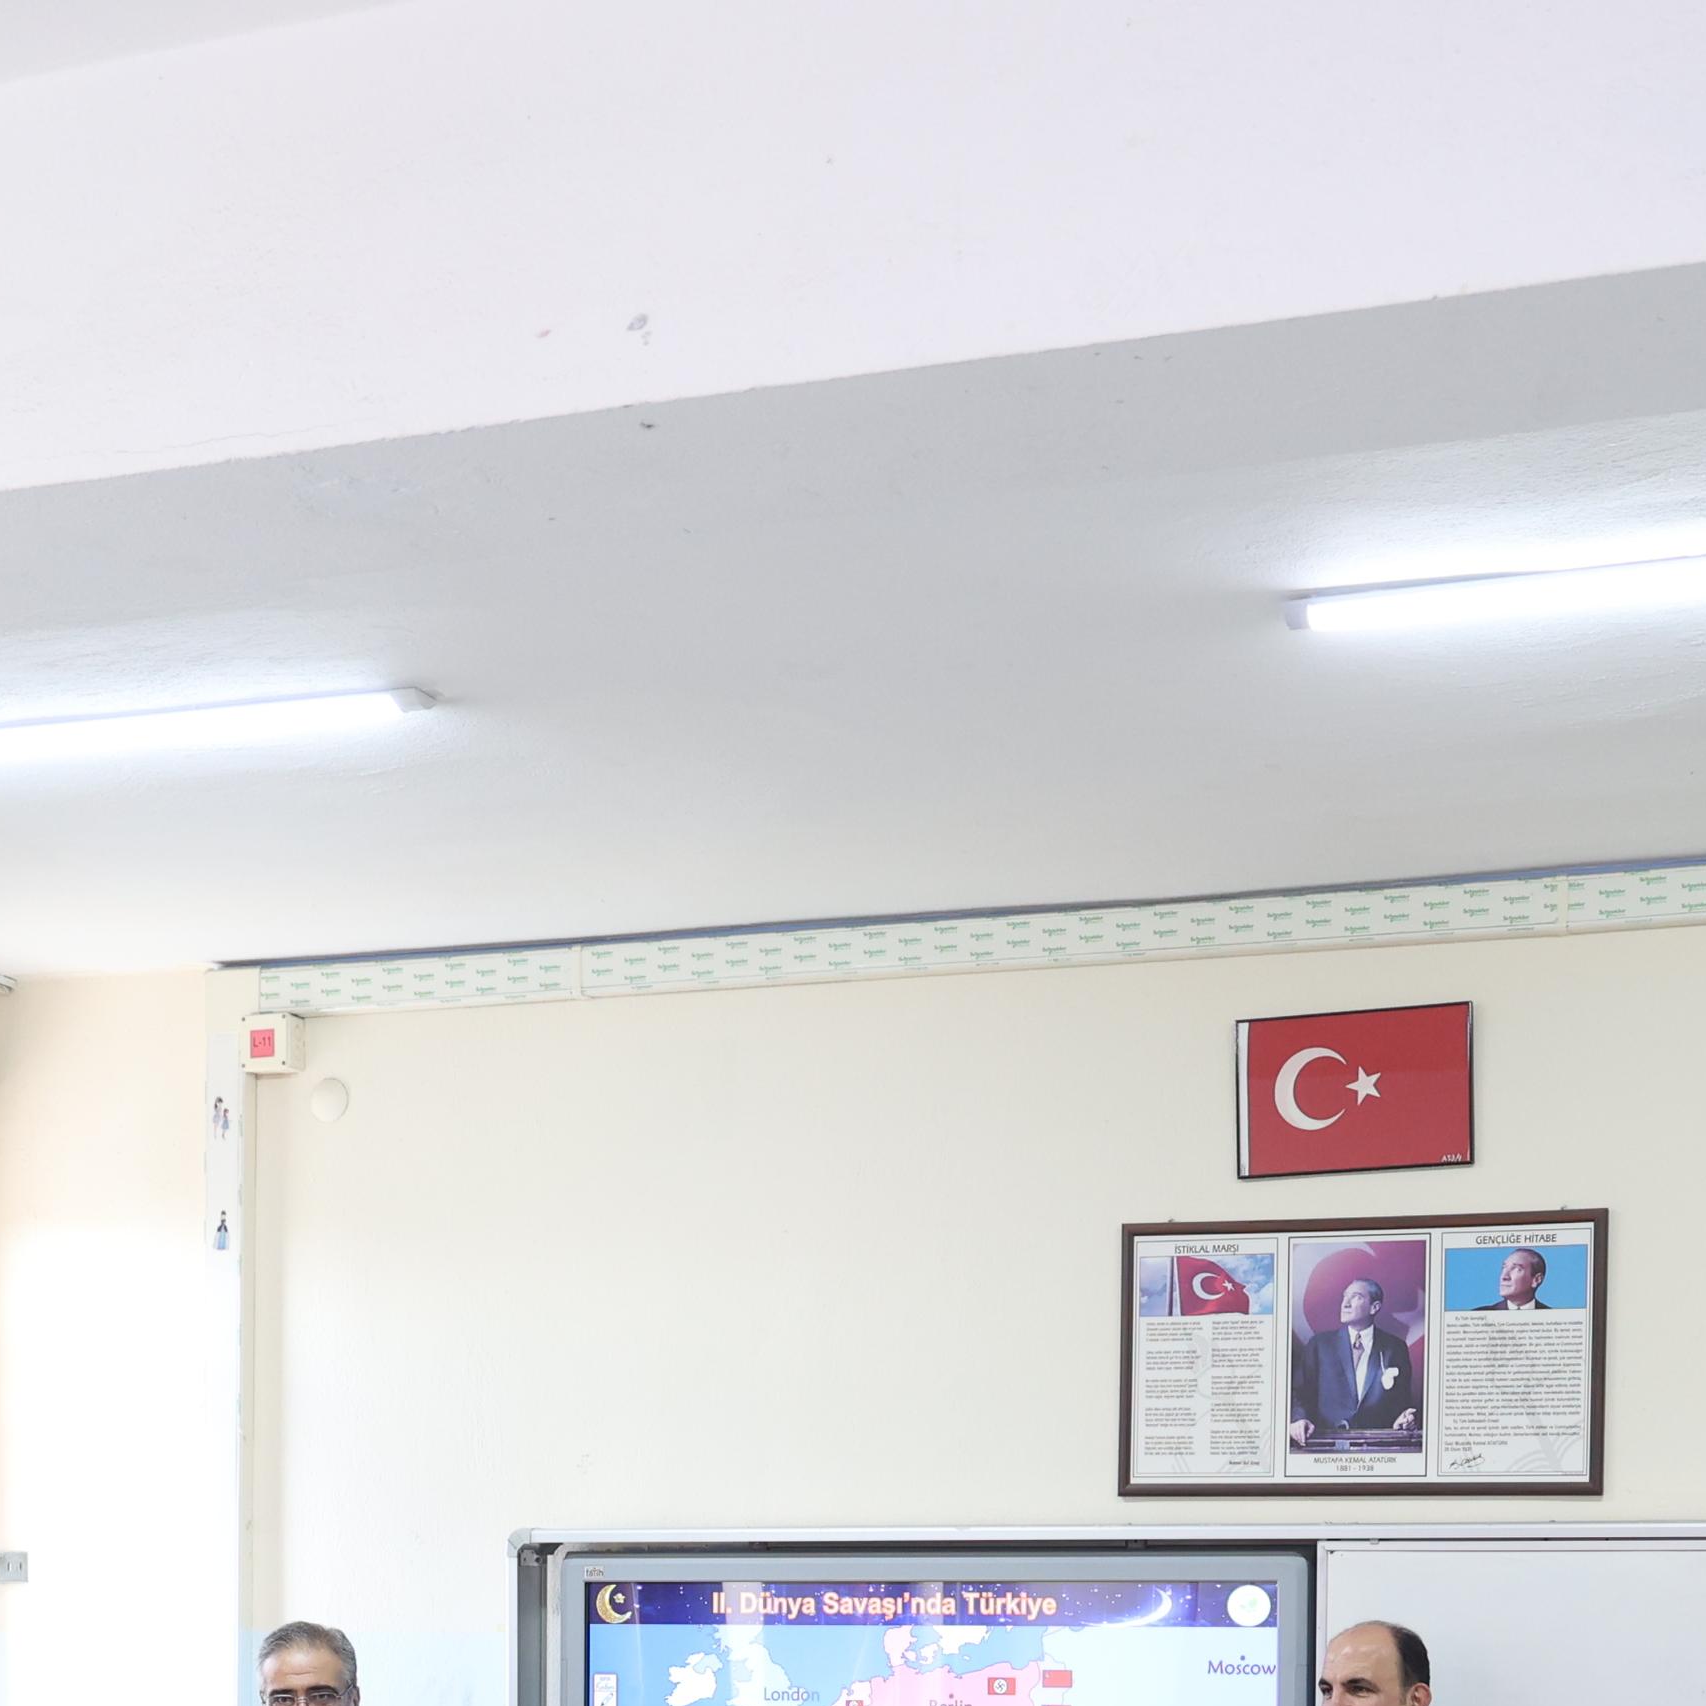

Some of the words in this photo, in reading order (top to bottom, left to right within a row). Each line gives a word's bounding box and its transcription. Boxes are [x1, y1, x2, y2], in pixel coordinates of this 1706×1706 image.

[253, 1036, 271, 1048] L-11
[711, 1592, 732, 1615] II.
[740, 1590, 815, 1619] Dünya
[965, 1591, 1058, 1620] Türkiye
[1207, 1659, 1276, 1675] Moscow
[763, 1686, 820, 1702] London
